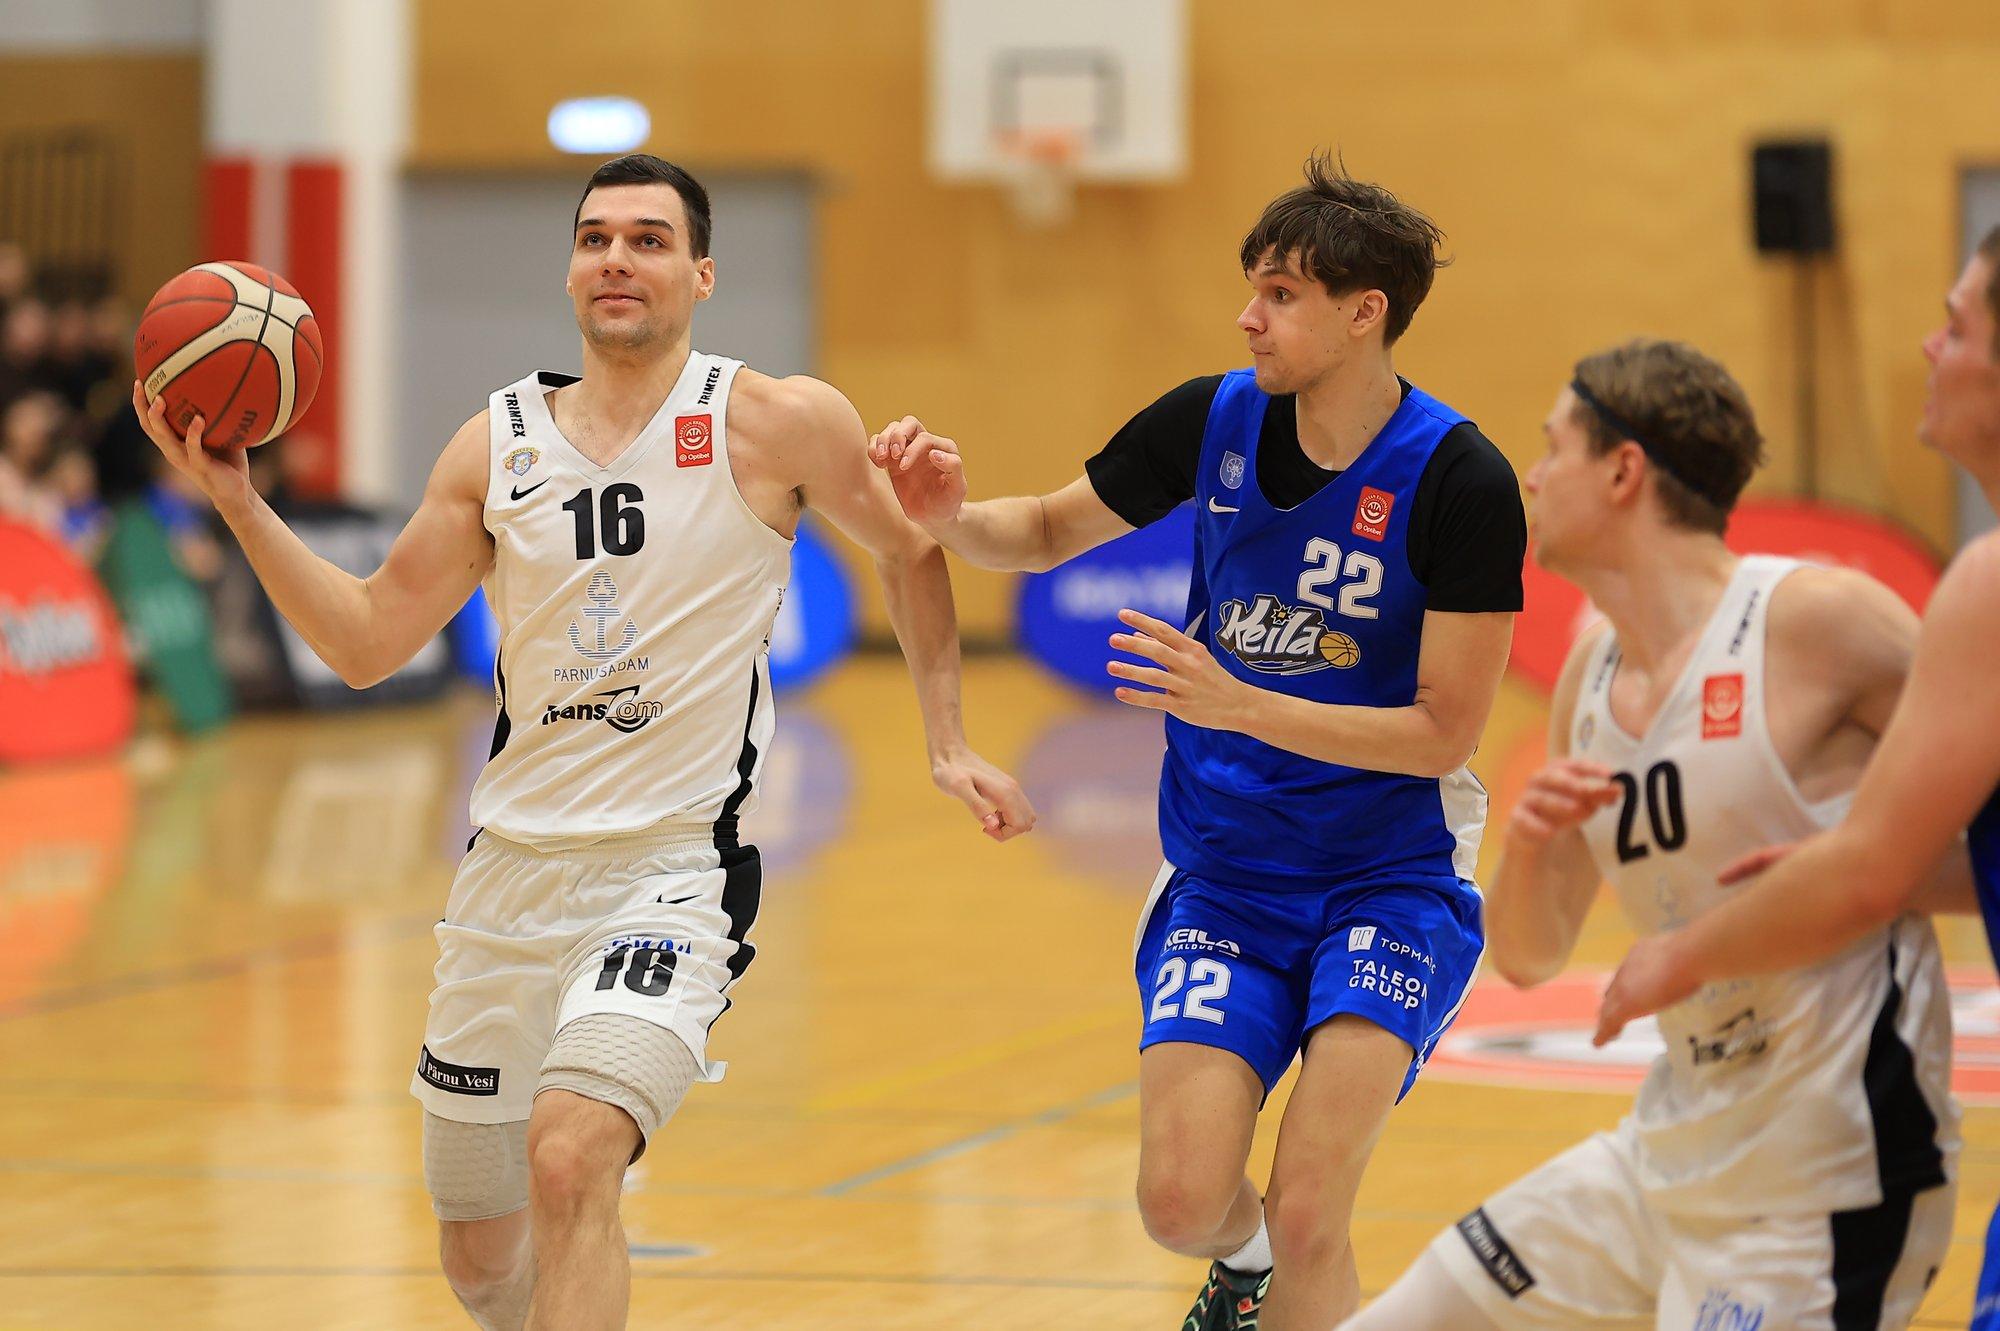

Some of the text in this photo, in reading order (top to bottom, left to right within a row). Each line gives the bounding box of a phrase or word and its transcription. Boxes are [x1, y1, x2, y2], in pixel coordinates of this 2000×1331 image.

[697, 366, 722, 405] TRIMTEX
[504, 391, 526, 438] TRIMTEX
[687, 452, 710, 461] Optibet
[562, 482, 646, 561] 16
[1362, 524, 1382, 536] Optibet
[1296, 536, 1385, 620] 22
[1216, 594, 1330, 661] Keila
[1609, 760, 1687, 865] 20
[594, 946, 678, 997] 16
[1149, 956, 1232, 1026] 22
[1348, 974, 1420, 1010] GRUPP
[464, 1074, 495, 1088] Vesi
